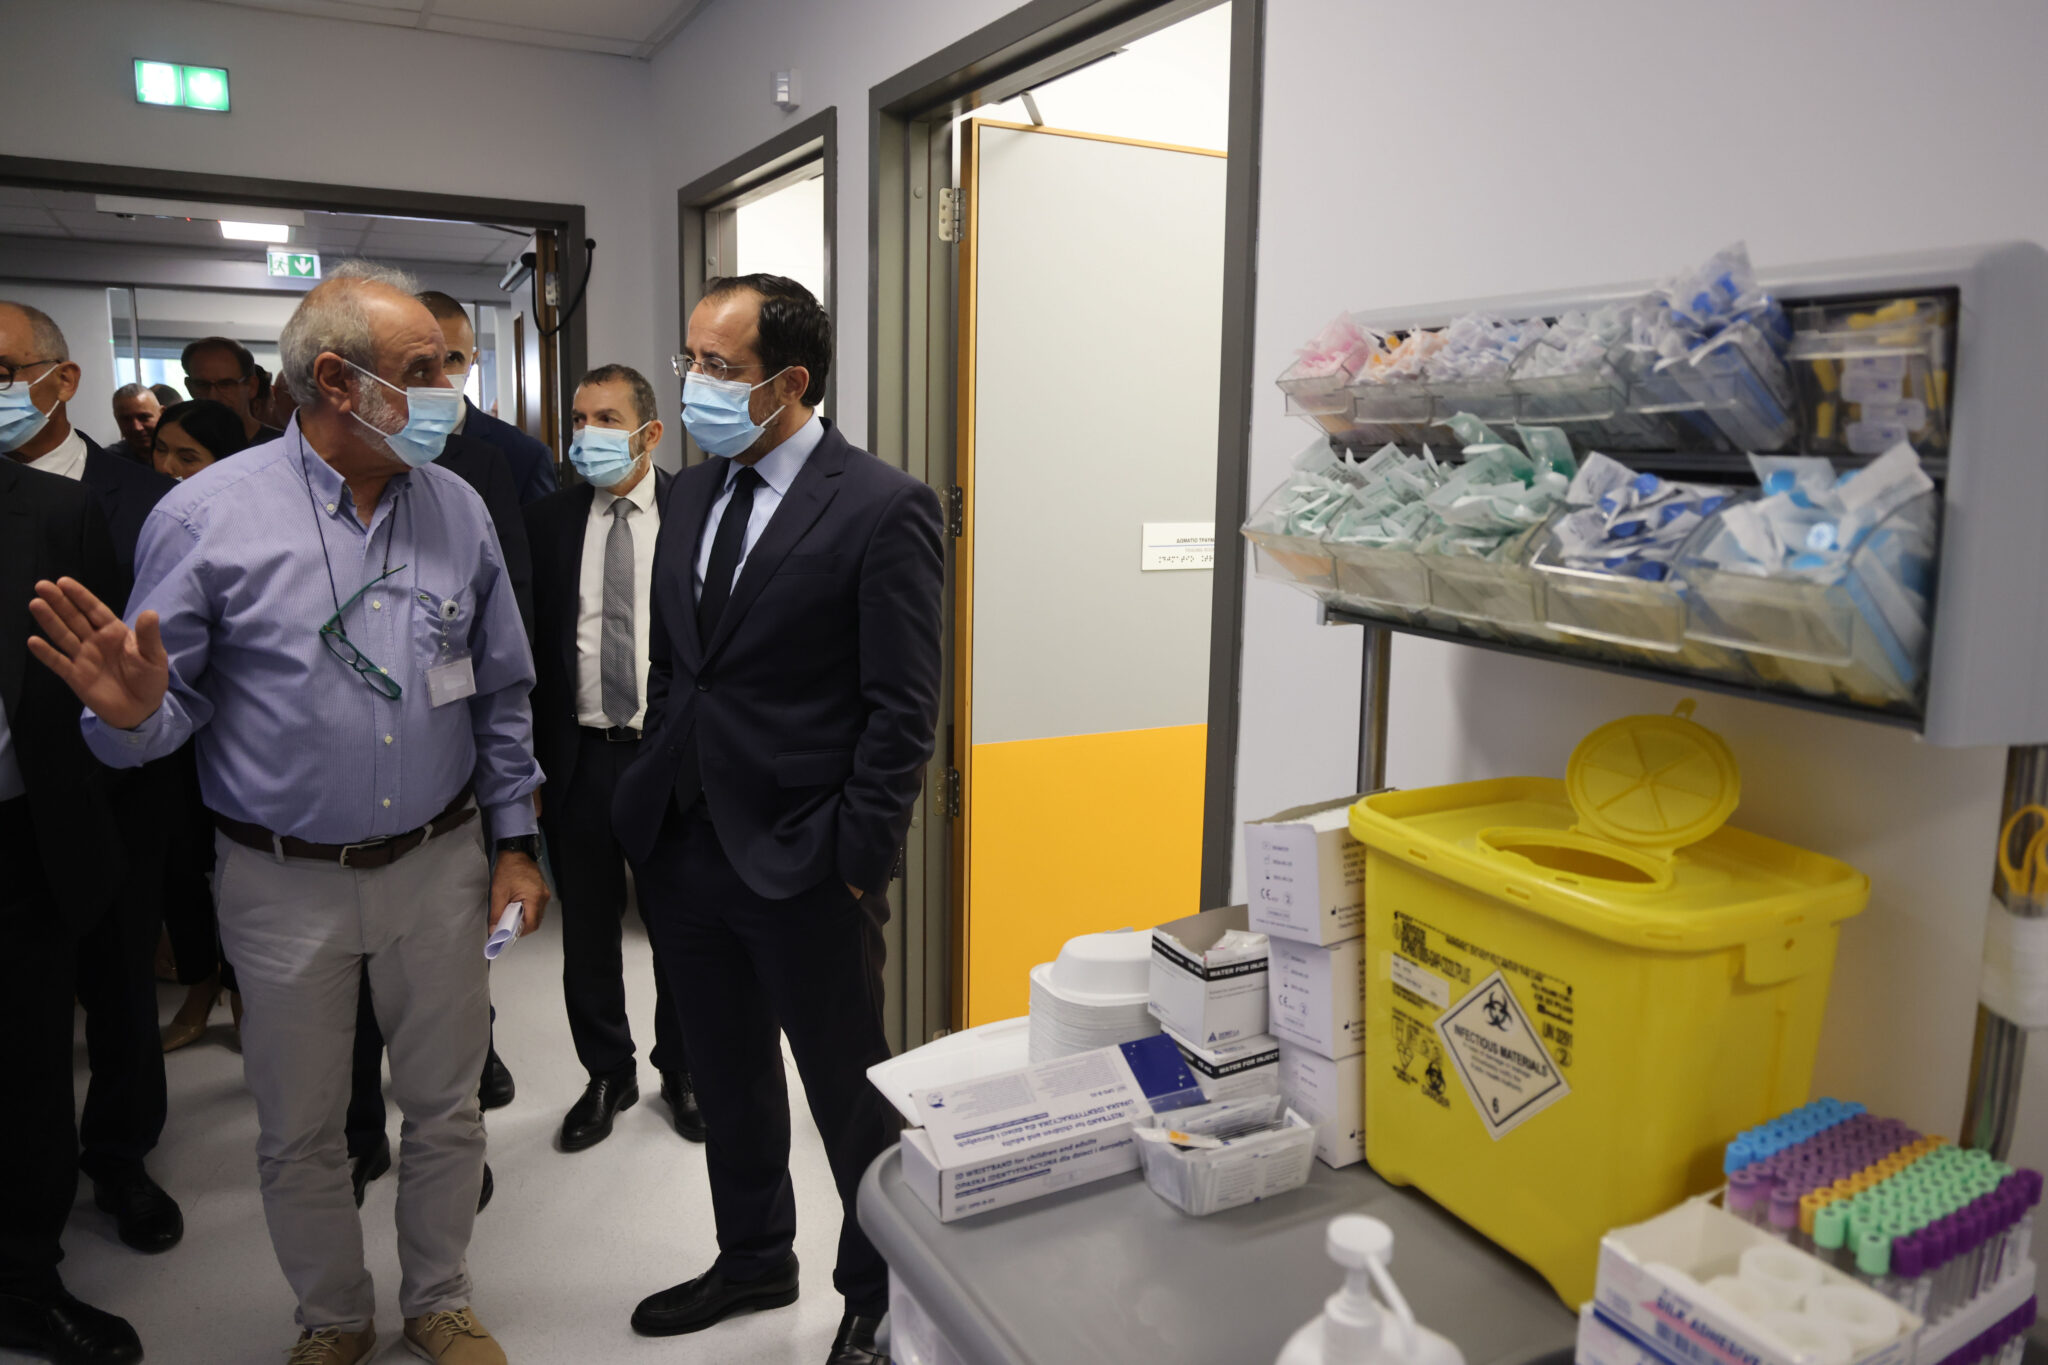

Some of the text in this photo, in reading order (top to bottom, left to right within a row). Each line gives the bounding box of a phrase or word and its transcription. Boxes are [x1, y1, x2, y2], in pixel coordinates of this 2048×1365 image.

[1209, 967, 1234, 977] WATER
[1235, 963, 1249, 973] FOR
[1454, 1023, 1498, 1054] INFECTIOUS
[1500, 1045, 1548, 1077] MATERIALS
[1218, 1062, 1241, 1074] WATER
[1242, 1058, 1256, 1069] FOR
[1492, 1096, 1499, 1114] 6
[955, 1172, 964, 1181] ID
[966, 1160, 1012, 1178] WRISTBAND
[1026, 1149, 1057, 1161] children
[1059, 1143, 1073, 1153] and
[1075, 1138, 1097, 1149] adults
[955, 1177, 986, 1190] OPASKA
[1059, 1154, 1071, 1162] dla
